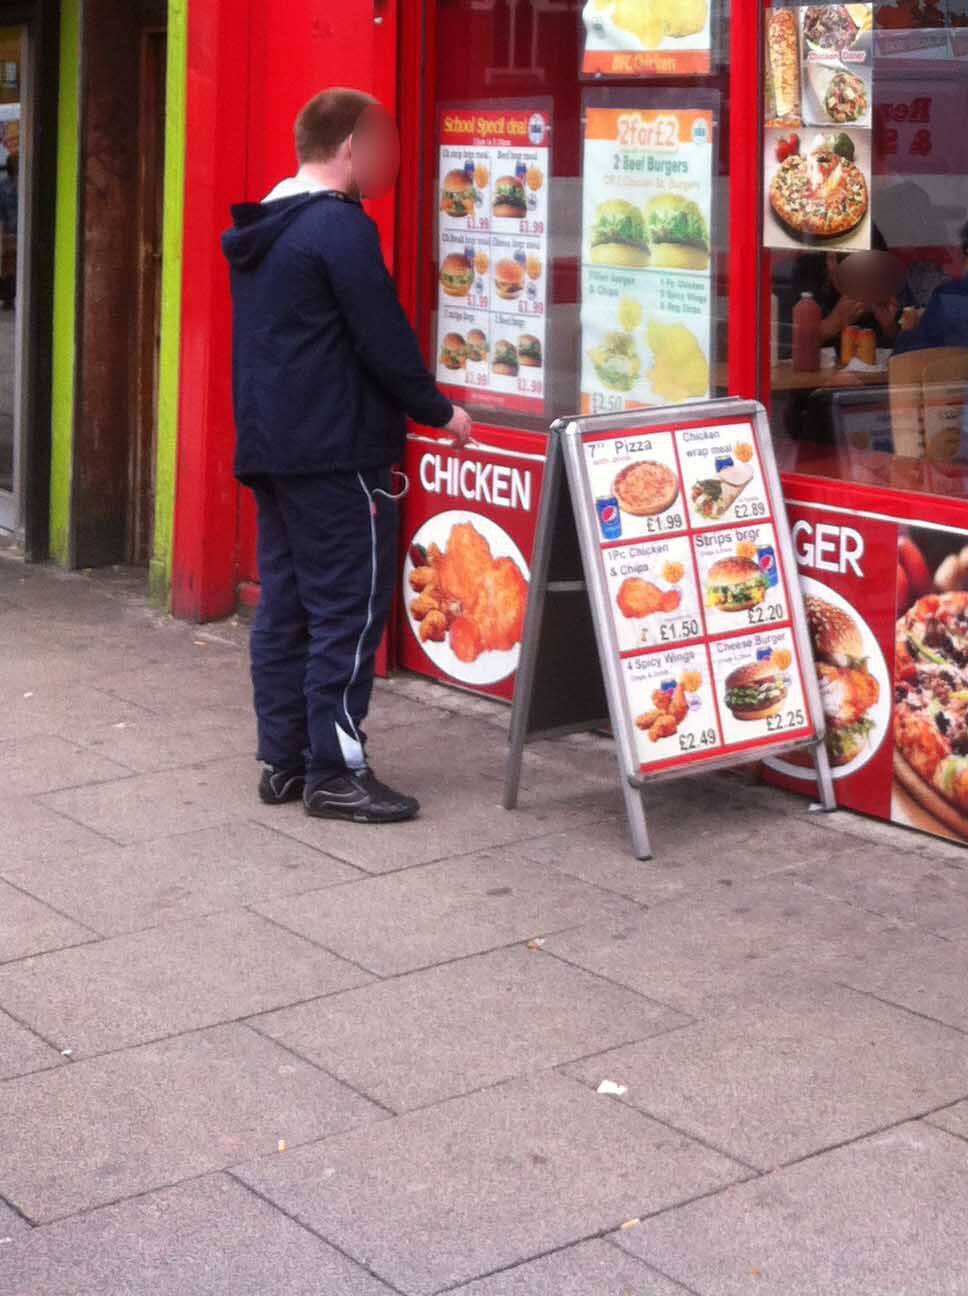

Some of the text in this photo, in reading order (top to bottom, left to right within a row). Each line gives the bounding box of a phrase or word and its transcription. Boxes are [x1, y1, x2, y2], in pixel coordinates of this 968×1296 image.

[647, 156, 689, 176] Burgers
[682, 430, 721, 443] Chicken
[615, 440, 653, 455] Pizza
[686, 444, 732, 458] wrap meal
[419, 453, 532, 512] CHICKEN
[734, 502, 767, 519] £2.89
[647, 513, 683, 533] £1.99
[695, 532, 733, 548] Strips
[629, 543, 669, 559] Chicken
[749, 604, 784, 625] £2.20
[659, 619, 699, 641] £1.50
[716, 632, 787, 654] Cheese Burger
[636, 657, 662, 672] Spicy
[665, 650, 696, 665] Wings
[766, 709, 805, 732] £2.25
[679, 728, 716, 751] £2.49
